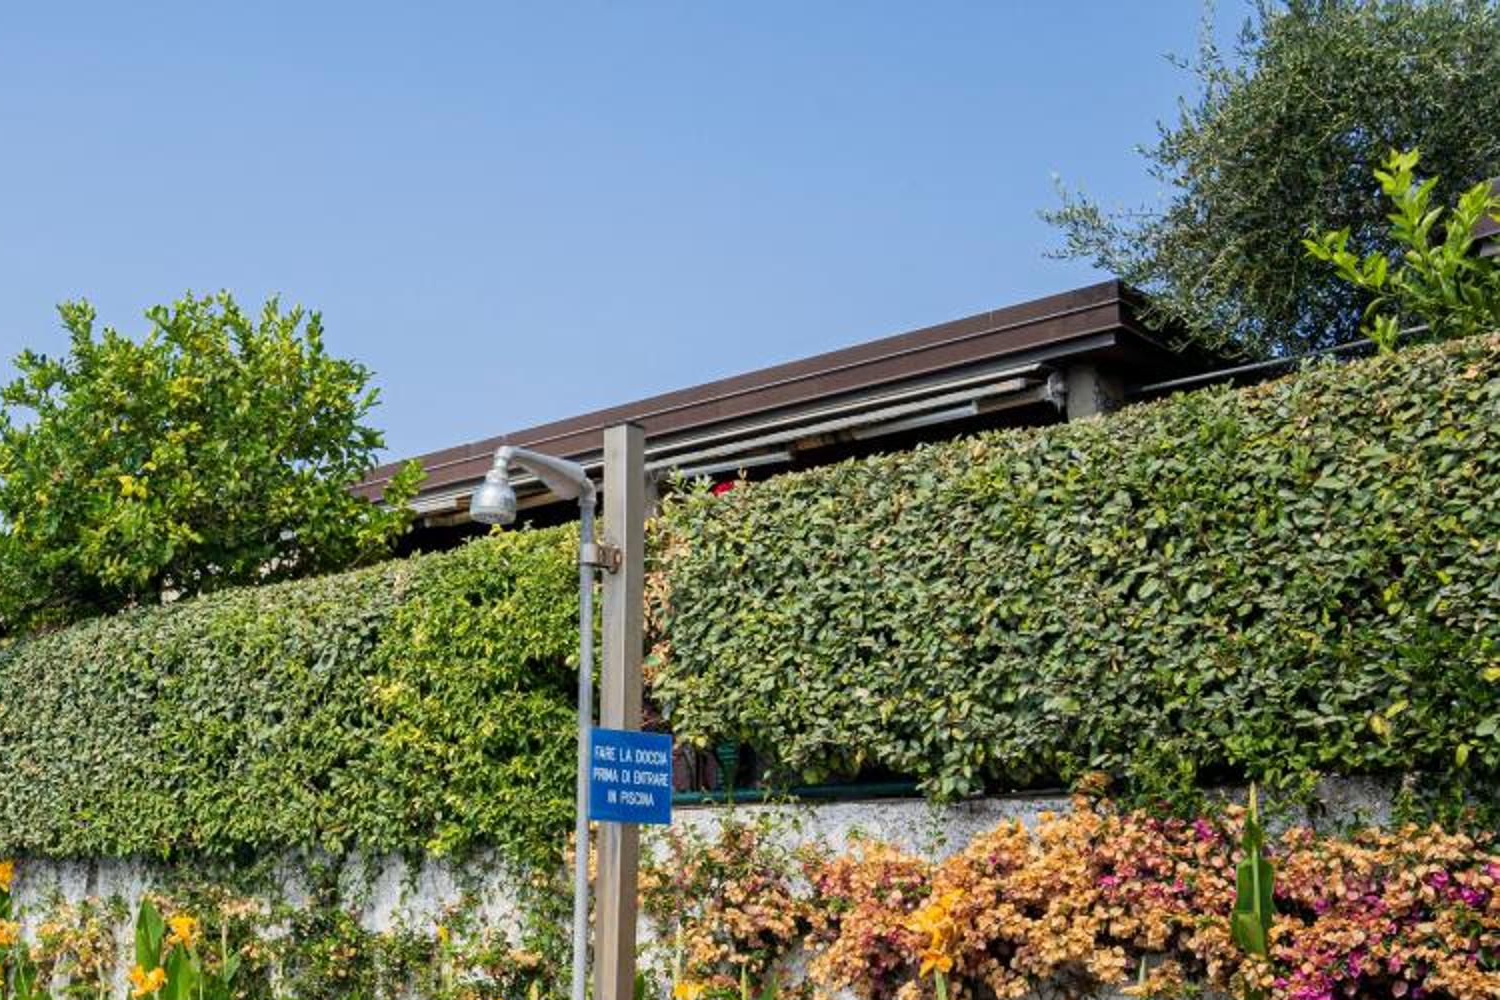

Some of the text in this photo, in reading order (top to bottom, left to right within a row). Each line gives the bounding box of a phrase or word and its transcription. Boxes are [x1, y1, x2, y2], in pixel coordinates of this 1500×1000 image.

[595, 745, 668, 766] FARE LA DOCCIA
[594, 767, 668, 787] PRIMA DI ENTRARE
[607, 790, 655, 806] IN PISCINA
